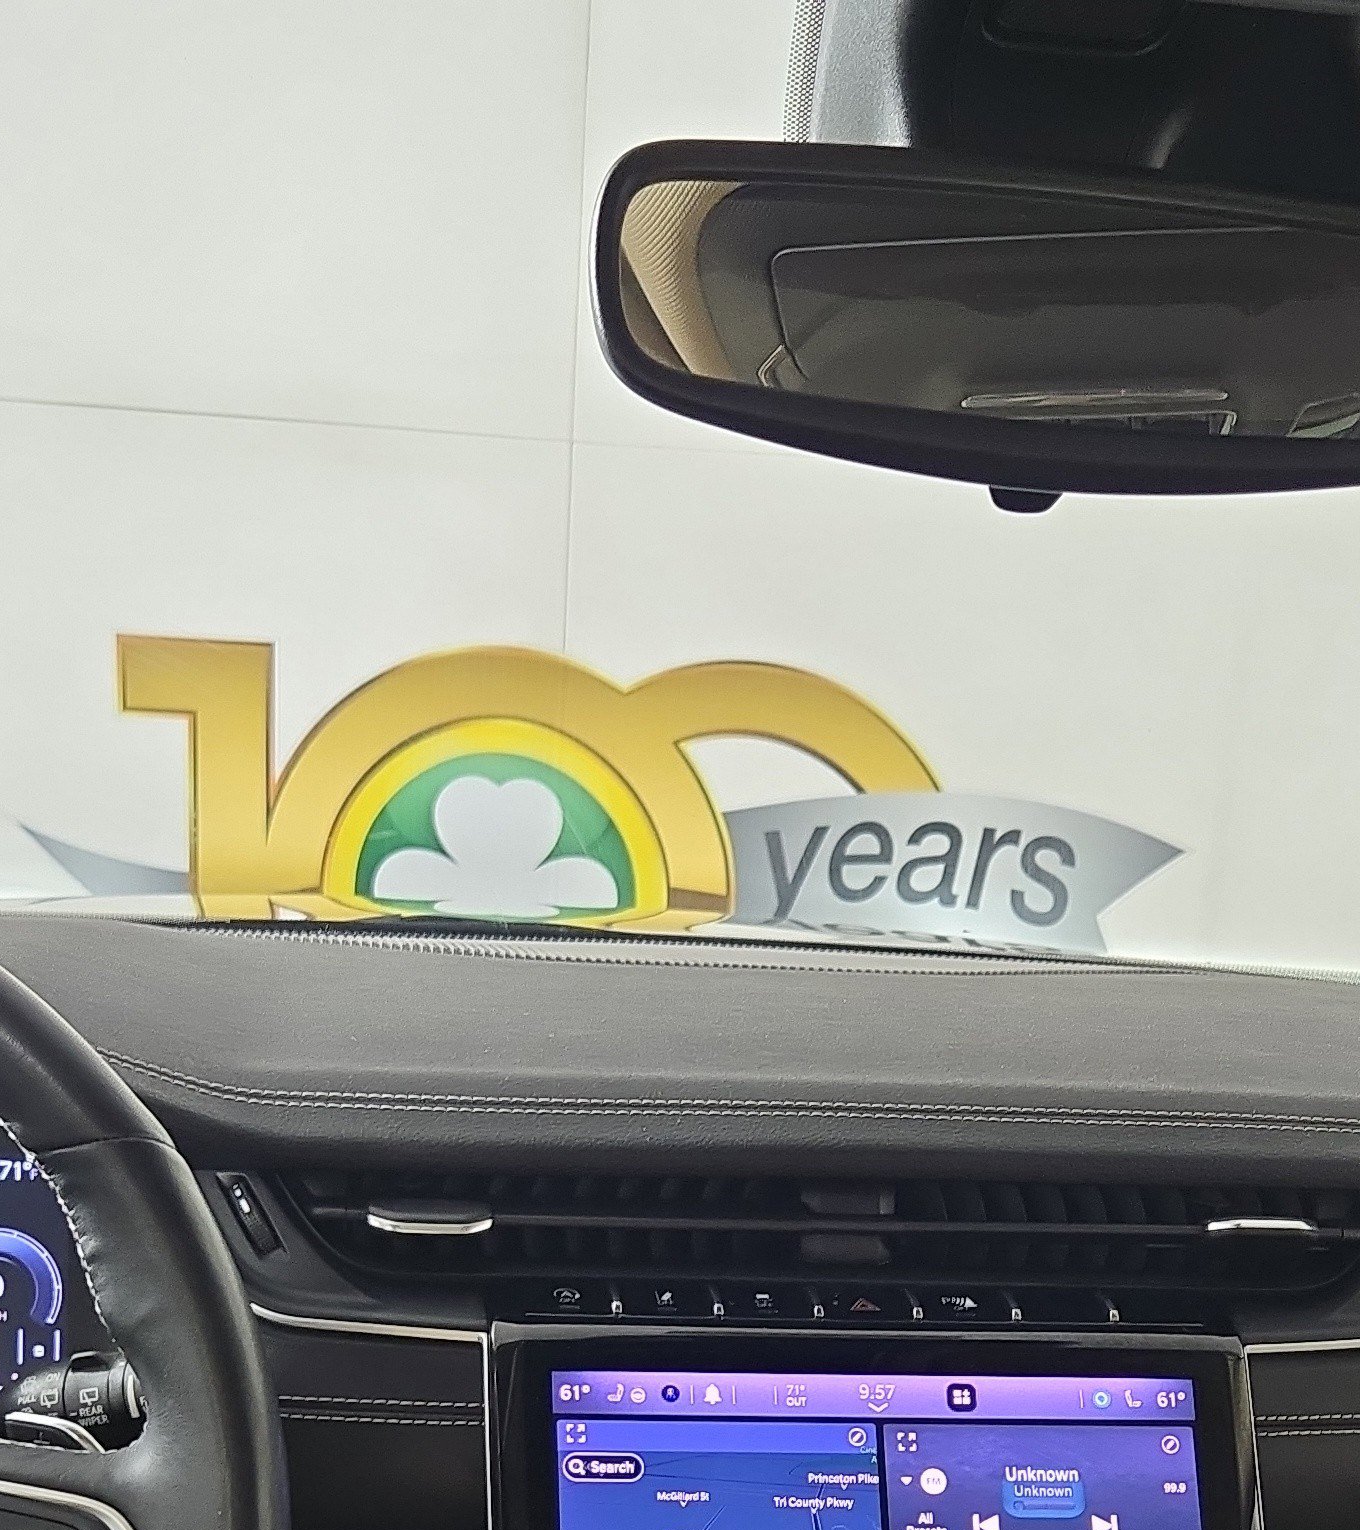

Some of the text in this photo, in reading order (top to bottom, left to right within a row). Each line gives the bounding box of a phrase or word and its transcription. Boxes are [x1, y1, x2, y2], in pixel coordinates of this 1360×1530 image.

[765, 820, 1075, 927] years
[859, 1383, 896, 1400] 9:57
[786, 1396, 807, 1407] OUT
[78, 1405, 104, 1417] REAR
[590, 1460, 636, 1475] Search
[808, 1472, 880, 1484] Princeton Pike
[1005, 1466, 1079, 1483] Unknown
[1014, 1485, 1073, 1498] Unknown
[1163, 1482, 1187, 1494] 99.9
[773, 1496, 854, 1510] Tri County Pkwy
[918, 1512, 933, 1525] All
